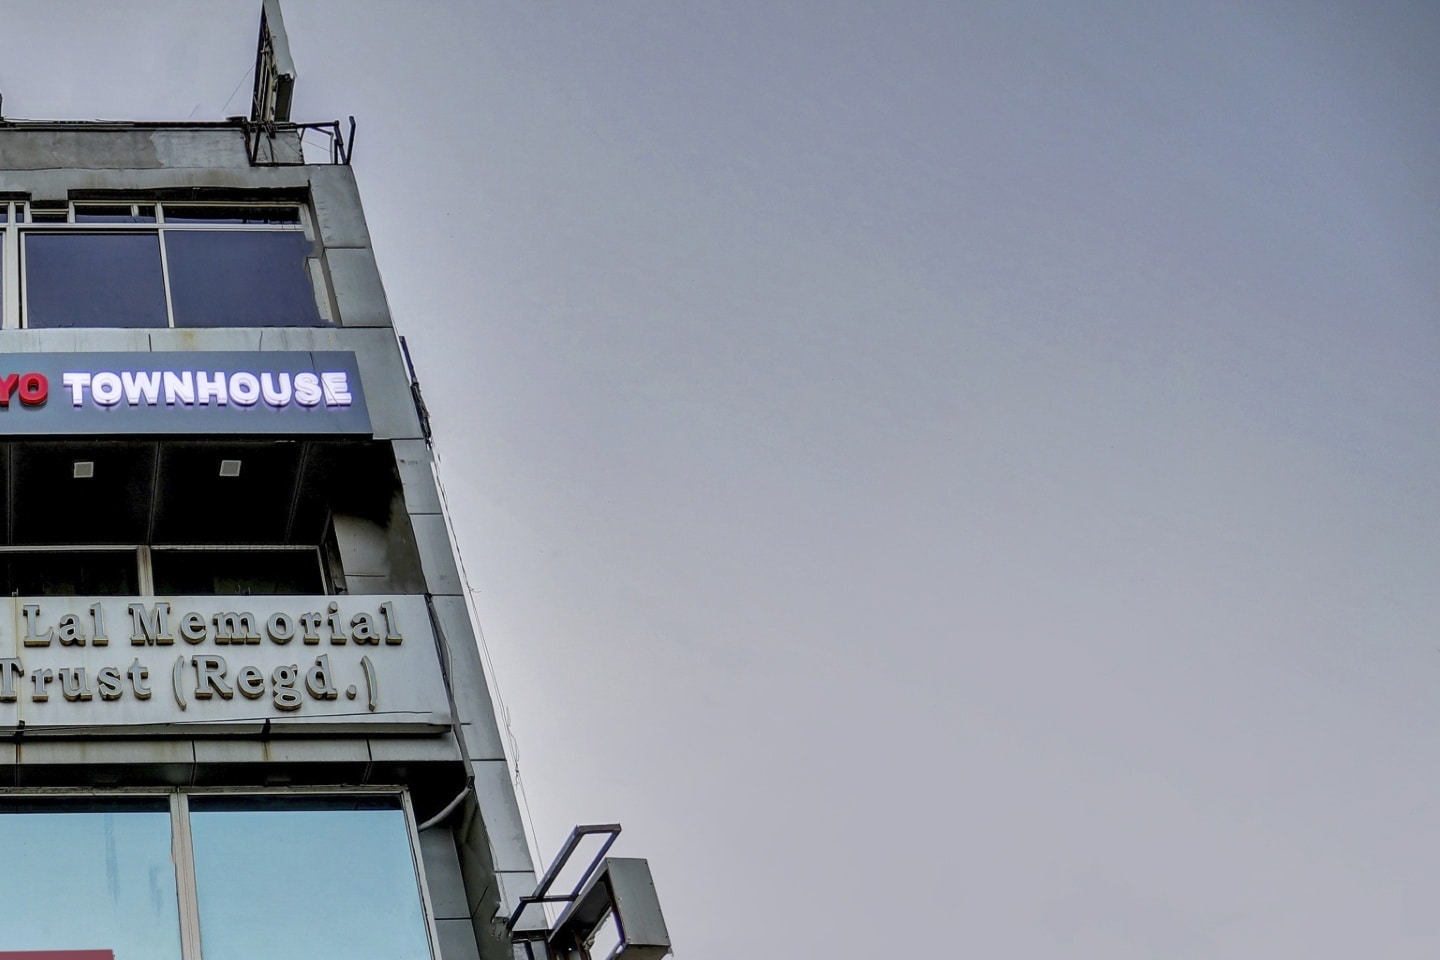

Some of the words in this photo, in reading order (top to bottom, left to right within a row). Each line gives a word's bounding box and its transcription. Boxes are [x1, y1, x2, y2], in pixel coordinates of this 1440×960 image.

[62, 371, 352, 407] TOWNHOUSE
[23, 602, 109, 647] Lal
[128, 601, 403, 646] Memorial
[172, 653, 378, 712] (Regd.)
